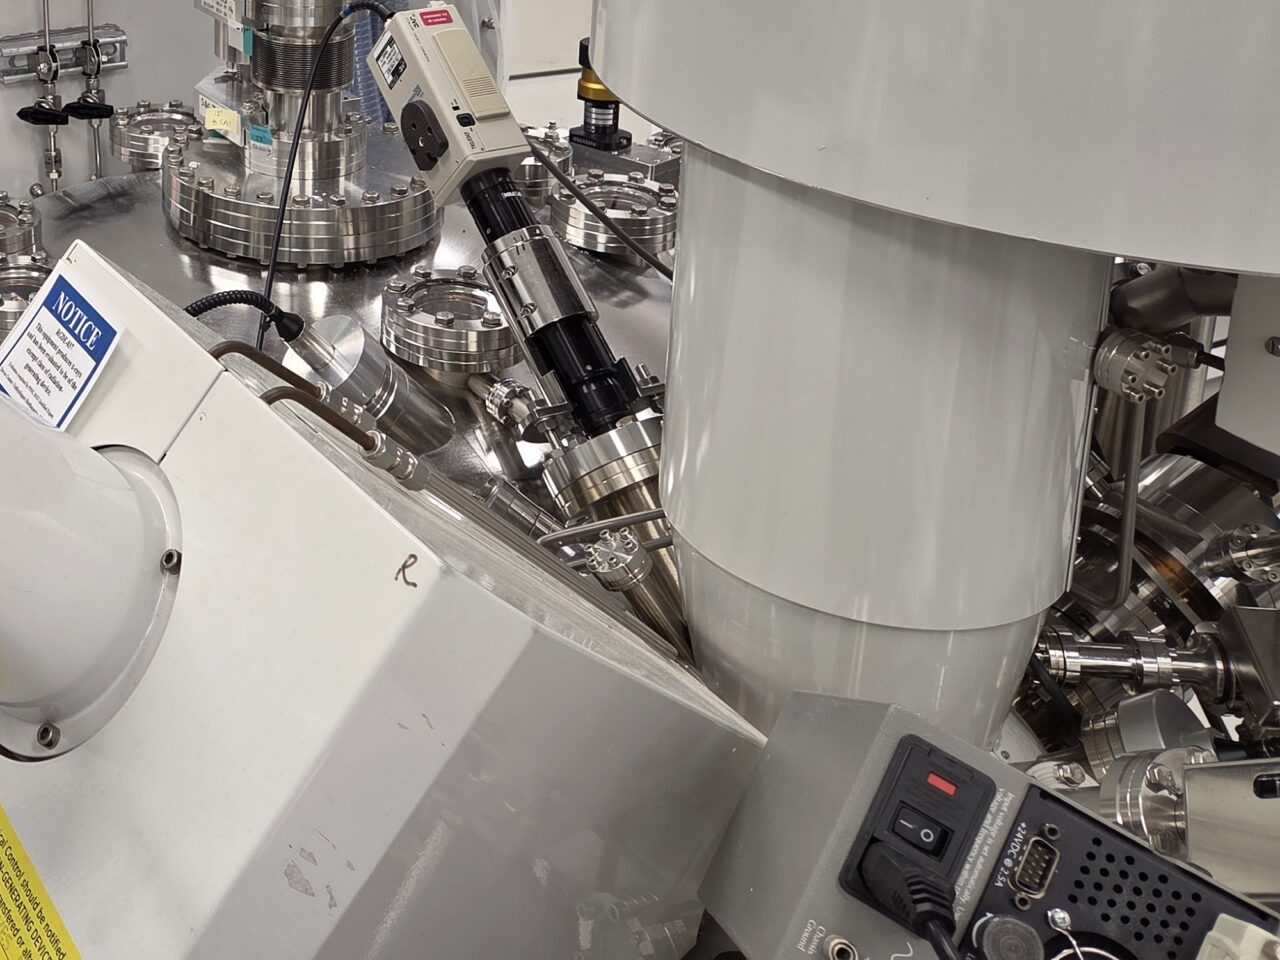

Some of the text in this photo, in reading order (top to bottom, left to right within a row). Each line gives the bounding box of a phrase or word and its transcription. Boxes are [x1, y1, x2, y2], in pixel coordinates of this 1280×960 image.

[52, 291, 102, 351] NOTICE
[395, 553, 418, 588] R
[1001, 792, 1015, 812] Input
[990, 812, 1005, 838] voltage
[1008, 821, 1027, 858] +24VDC
[995, 866, 1010, 887] 2.5A
[5, 846, 24, 880] Control
[21, 879, 40, 911] should
[36, 907, 46, 925] be
[42, 923, 67, 960] notified
[16, 936, 25, 948] or
[796, 919, 817, 952] Ground
